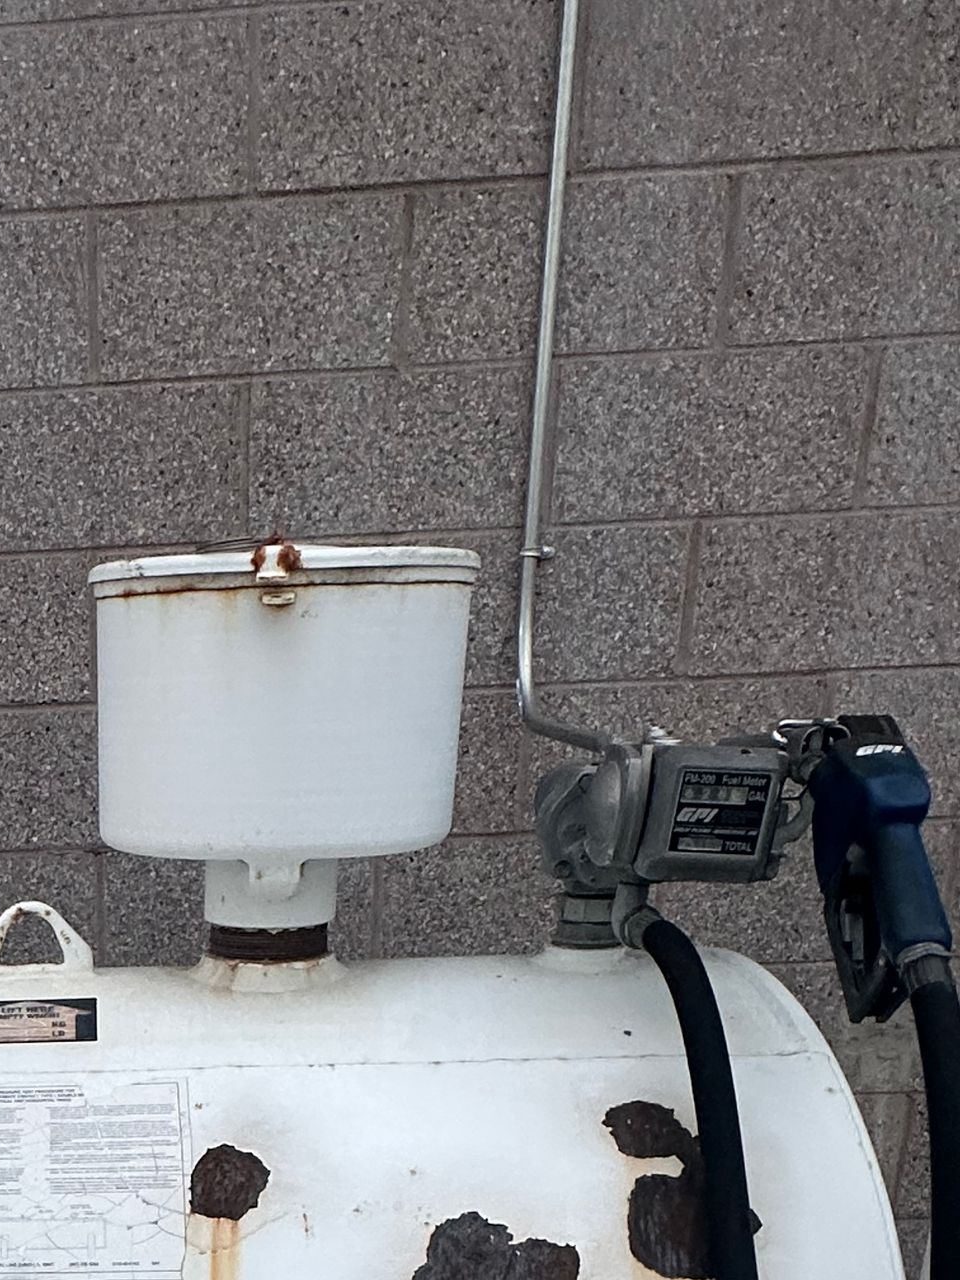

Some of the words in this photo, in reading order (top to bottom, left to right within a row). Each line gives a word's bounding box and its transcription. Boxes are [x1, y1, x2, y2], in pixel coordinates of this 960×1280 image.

[722, 775, 741, 785] Fuel
[748, 791, 766, 801] GAL
[676, 807, 719, 822] GPI
[724, 841, 752, 852] TOTAL
